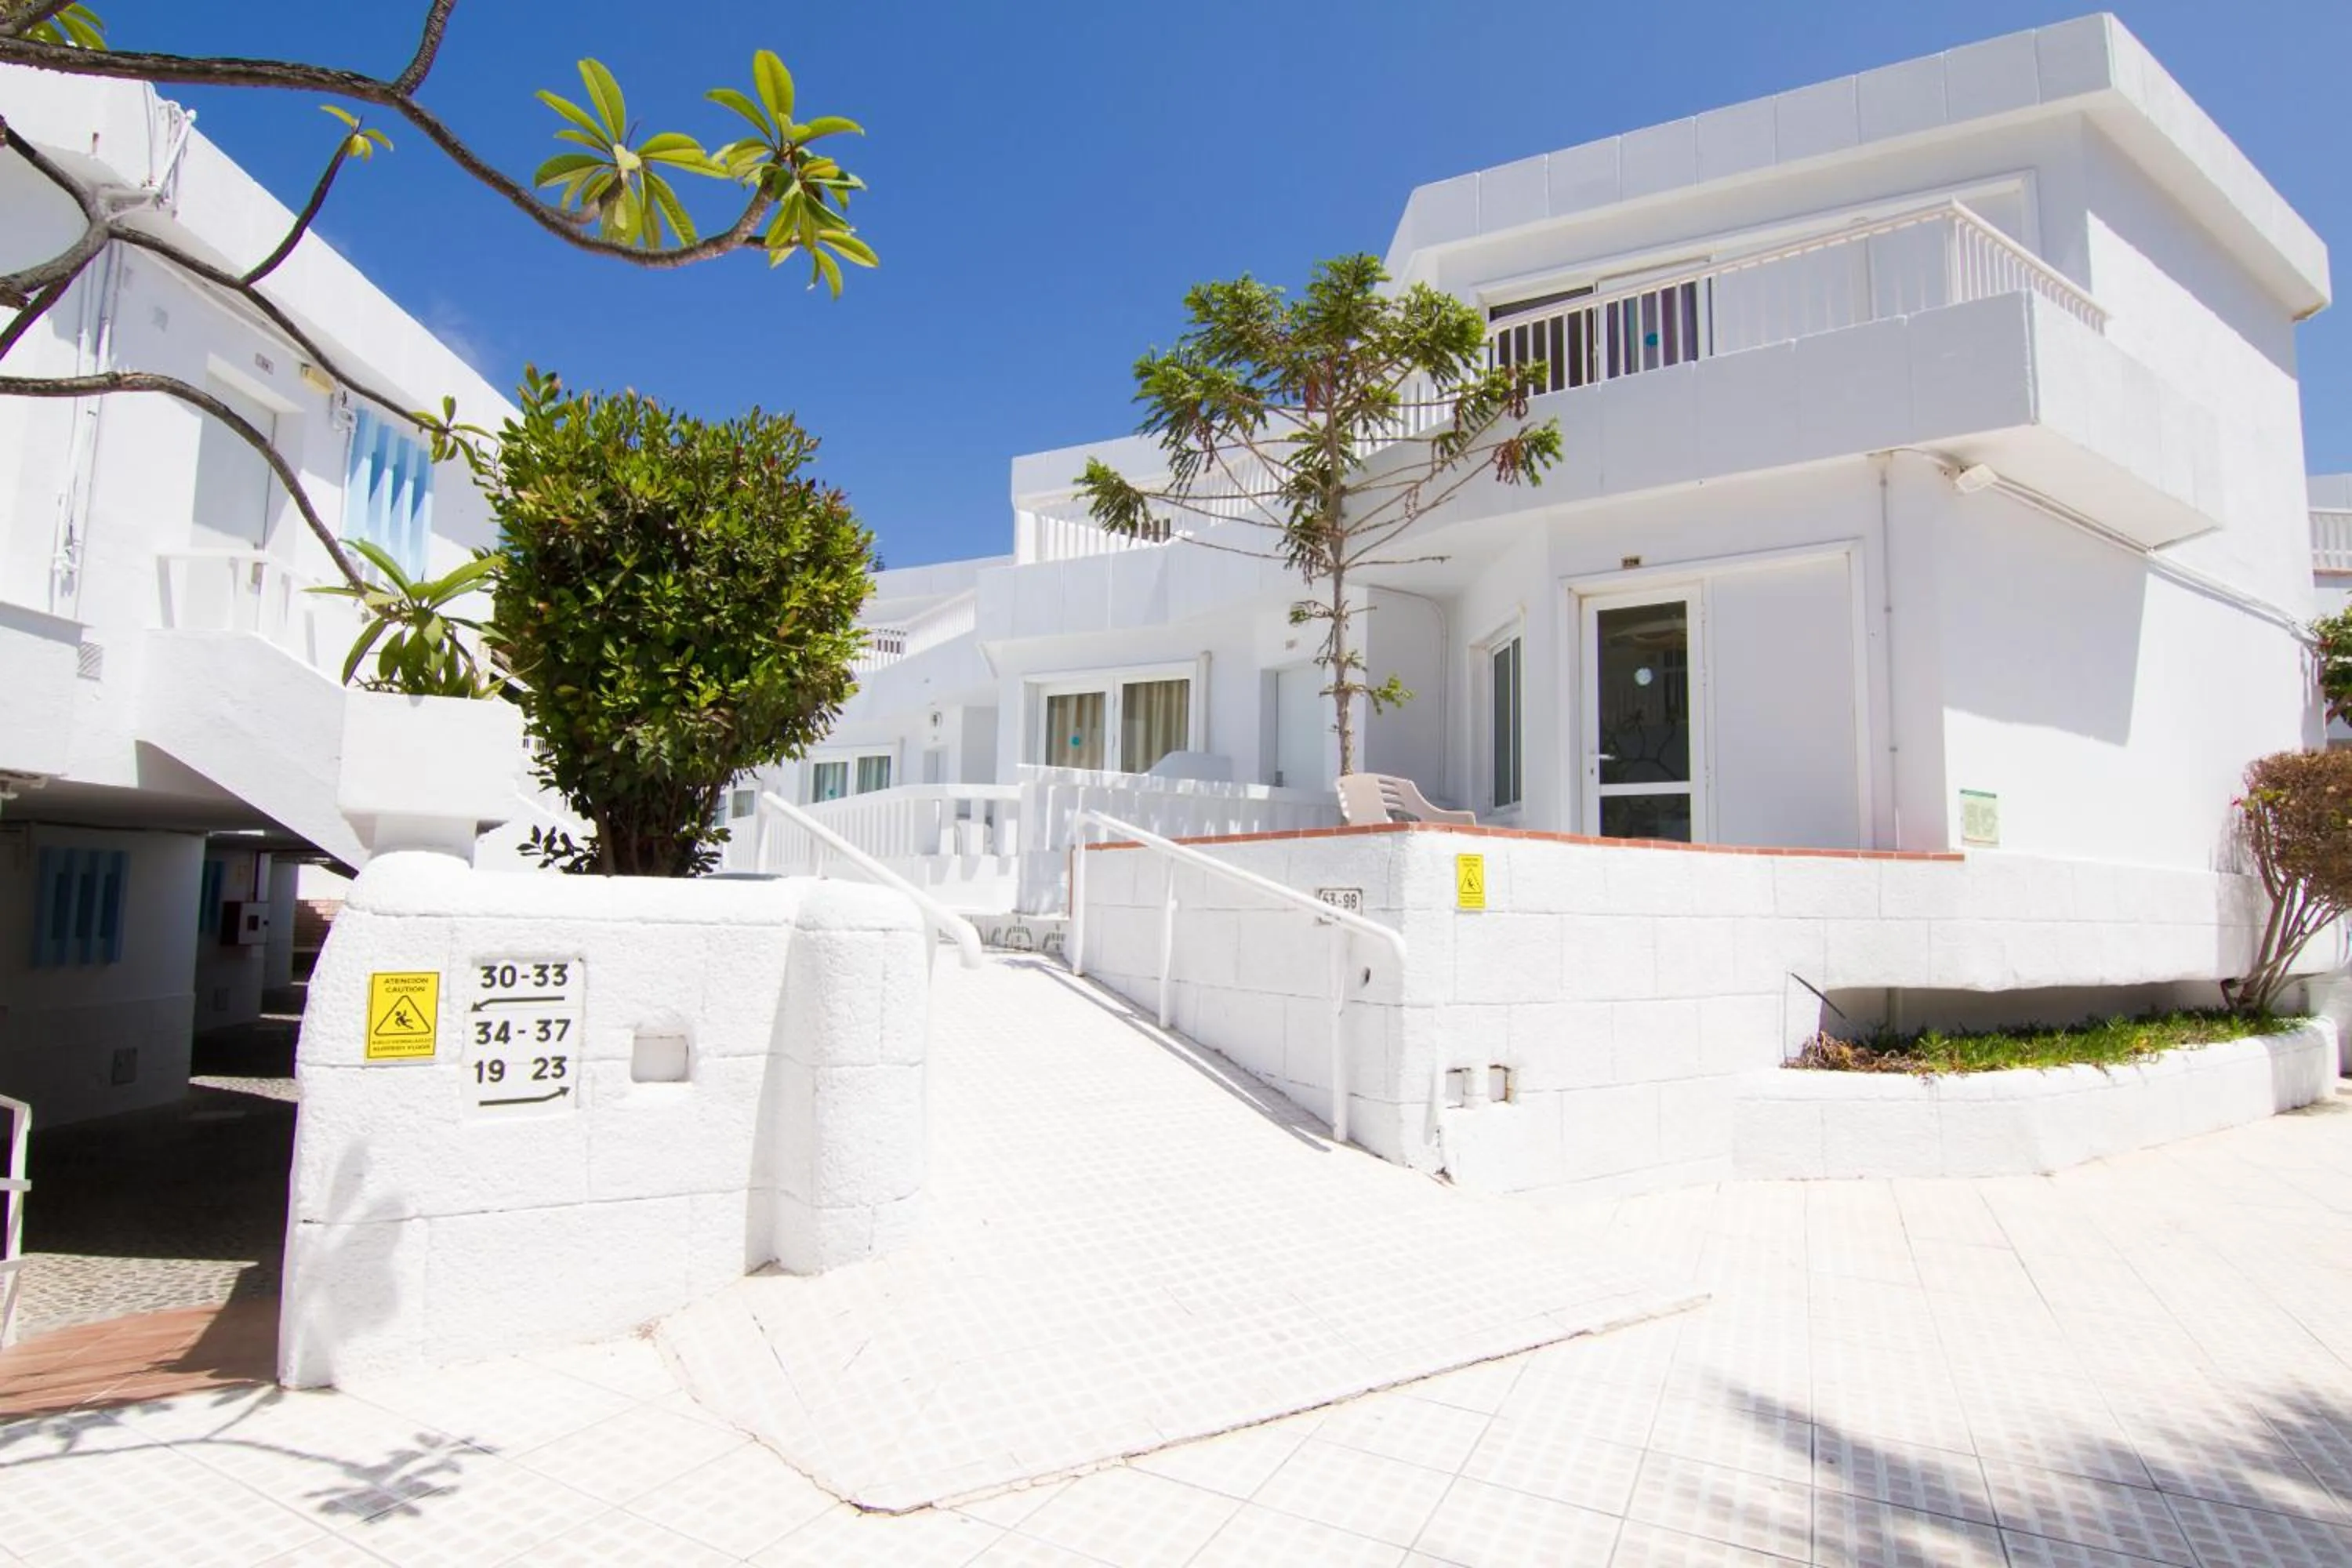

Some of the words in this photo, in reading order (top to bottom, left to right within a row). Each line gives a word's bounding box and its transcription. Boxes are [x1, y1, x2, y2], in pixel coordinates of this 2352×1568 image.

[480, 964, 568, 989] 30-33
[474, 1059, 505, 1083] 19
[532, 1055, 567, 1080] 23
